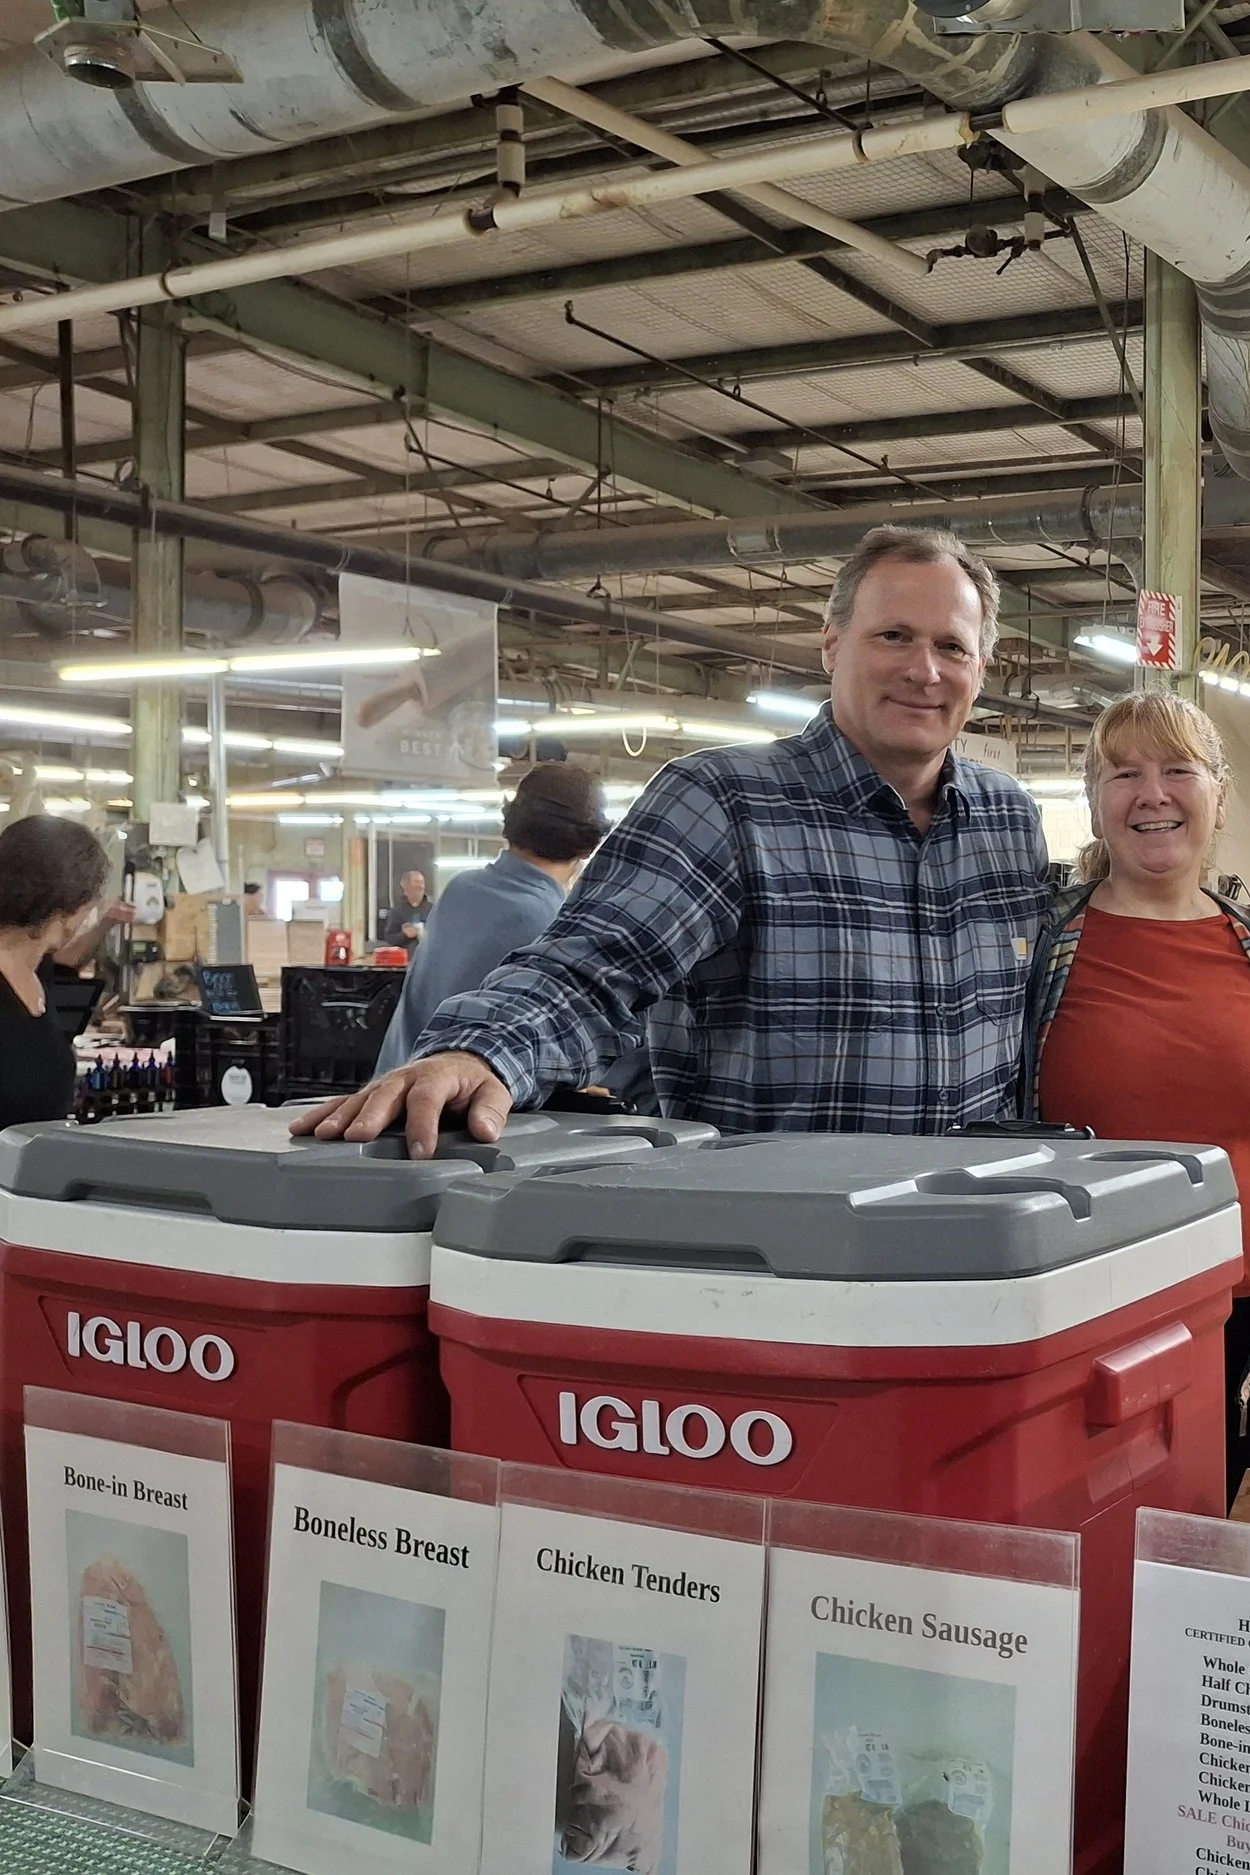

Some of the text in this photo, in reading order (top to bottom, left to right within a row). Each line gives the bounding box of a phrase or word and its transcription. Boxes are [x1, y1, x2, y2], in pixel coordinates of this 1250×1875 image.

[400, 739, 441, 757] BEST
[66, 1310, 236, 1382] IGLOO
[558, 1391, 793, 1466] IGLOO
[64, 1465, 188, 1510] Bone-in Breast
[293, 1505, 470, 1568] Boneless Breast
[535, 1546, 721, 1604] Chicken Tenders
[810, 1594, 1029, 1659] Chicken Sausage
[1184, 1627, 1246, 1647] CERTIFIED
[1203, 1655, 1246, 1675] Whole
[1201, 1675, 1232, 1692] Half
[1199, 1732, 1250, 1754] Bone-in
[1197, 1789, 1241, 1811] Whole
[1177, 1804, 1218, 1825] SALE
[1195, 1847, 1250, 1871] Chicken
